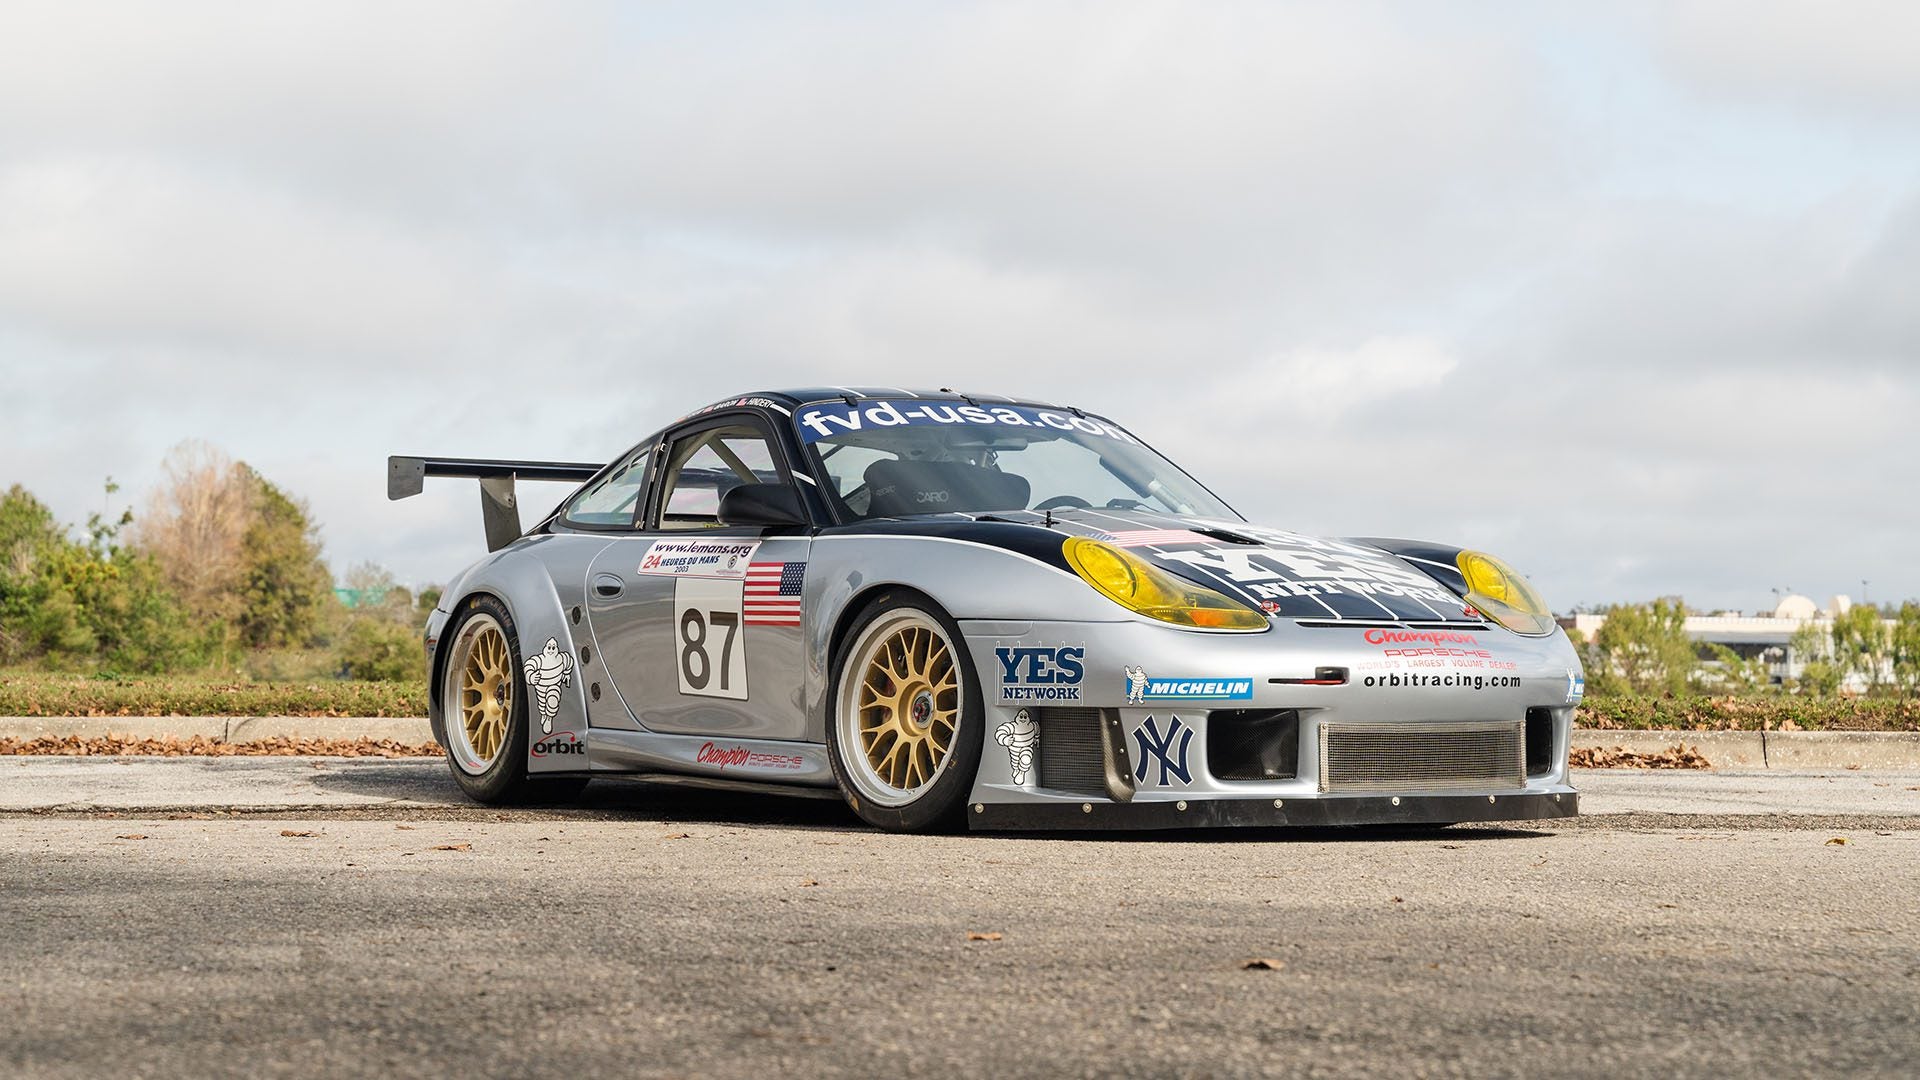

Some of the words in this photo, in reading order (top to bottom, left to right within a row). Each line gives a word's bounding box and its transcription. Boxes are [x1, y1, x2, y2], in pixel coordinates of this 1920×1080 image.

[655, 541, 753, 558] www.lemans.org
[643, 555, 662, 569] 24
[660, 558, 687, 567] HEURES
[687, 557, 697, 565] DU
[698, 555, 720, 564] MANS
[1153, 550, 1437, 590] YES
[1363, 628, 1479, 647] Champion
[680, 608, 739, 691] 87
[1384, 649, 1492, 658] PORSCHE
[995, 647, 1085, 685] YES
[1357, 660, 1400, 670] WORLD'S
[1407, 659, 1446, 668] LARGEST
[1451, 660, 1485, 668] VOLUME
[1150, 682, 1249, 694] MICHELIN
[1364, 672, 1521, 690] orbitracing.com
[1003, 687, 1080, 699] NETWORK
[533, 737, 584, 755] orbit
[697, 741, 750, 769] Champion
[750, 753, 803, 765] PORSCHE
